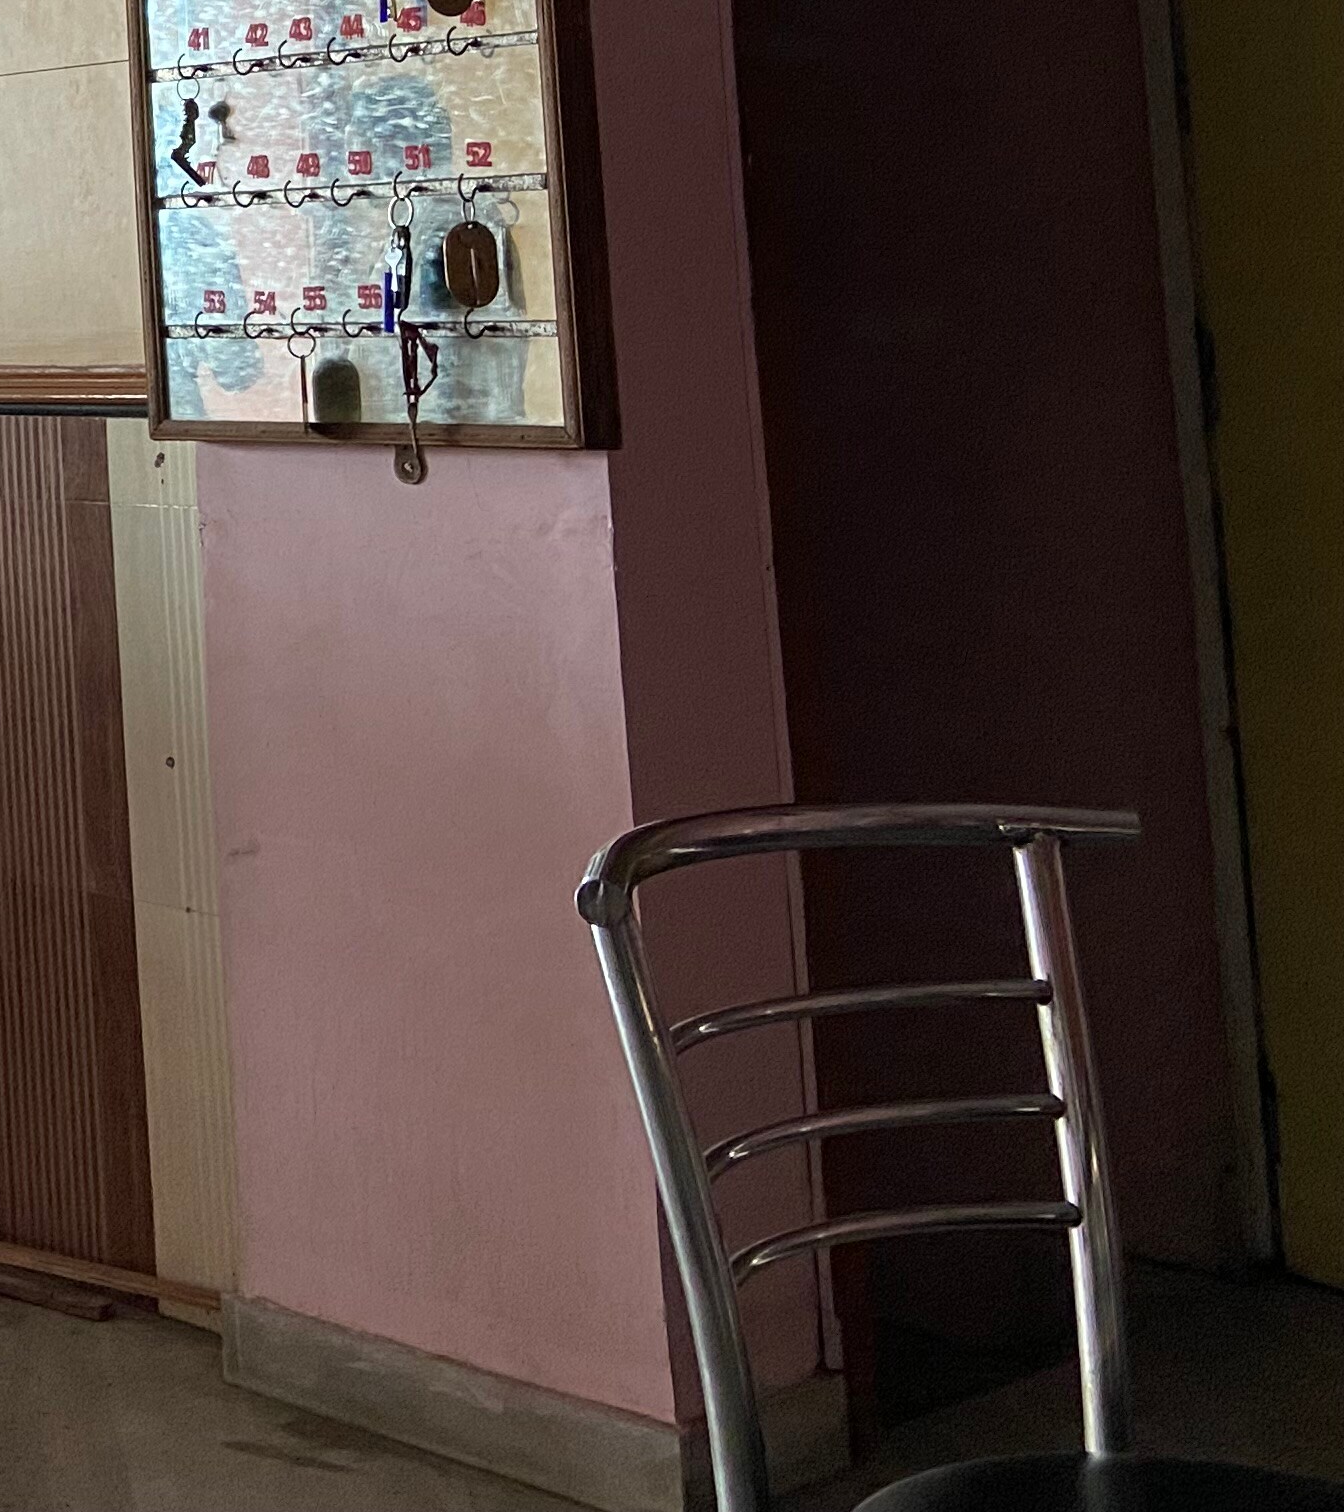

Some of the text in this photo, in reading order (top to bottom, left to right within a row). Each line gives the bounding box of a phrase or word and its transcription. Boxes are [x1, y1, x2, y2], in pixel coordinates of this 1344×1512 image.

[187, 27, 210, 51] 41
[245, 23, 269, 47] 42
[289, 16, 313, 41] 43
[340, 14, 365, 39] 44
[396, 6, 422, 32] 45
[247, 154, 270, 179] 48
[296, 152, 321, 177] 49
[348, 150, 372, 175] 50
[403, 144, 432, 170] 51
[465, 141, 493, 168] 52
[203, 284, 383, 315] 53 54 55 56
